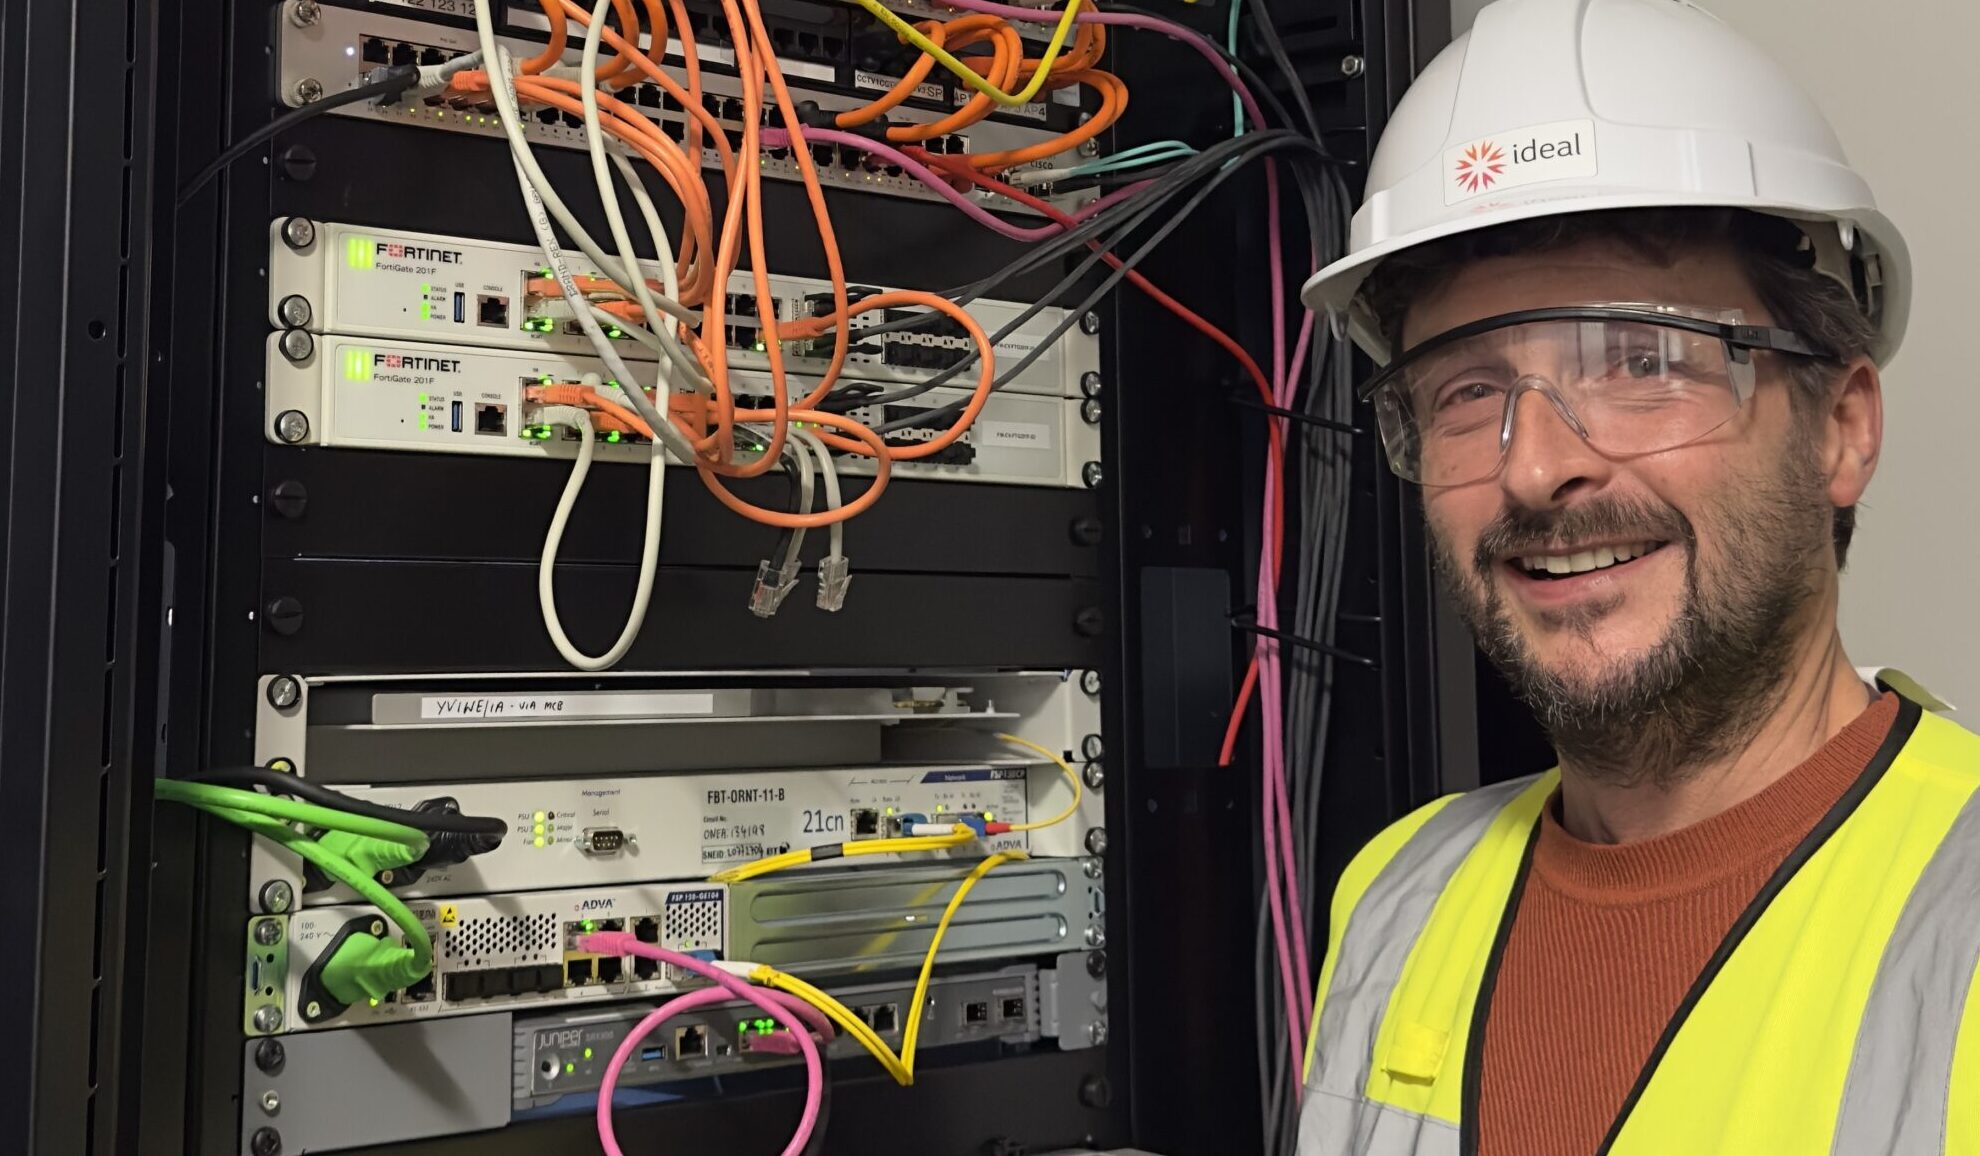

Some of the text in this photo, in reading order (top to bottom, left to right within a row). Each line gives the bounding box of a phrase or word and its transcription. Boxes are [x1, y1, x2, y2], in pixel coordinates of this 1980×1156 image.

[1512, 132, 1581, 164] ideal
[376, 243, 463, 264] FORTINET
[376, 262, 437, 275] FortiGate 201F
[374, 353, 461, 373] FORTINET
[373, 373, 435, 385] FortiGate 201F
[581, 788, 621, 798] Management
[802, 808, 844, 833] 21cn
[581, 899, 613, 911] ADVA
